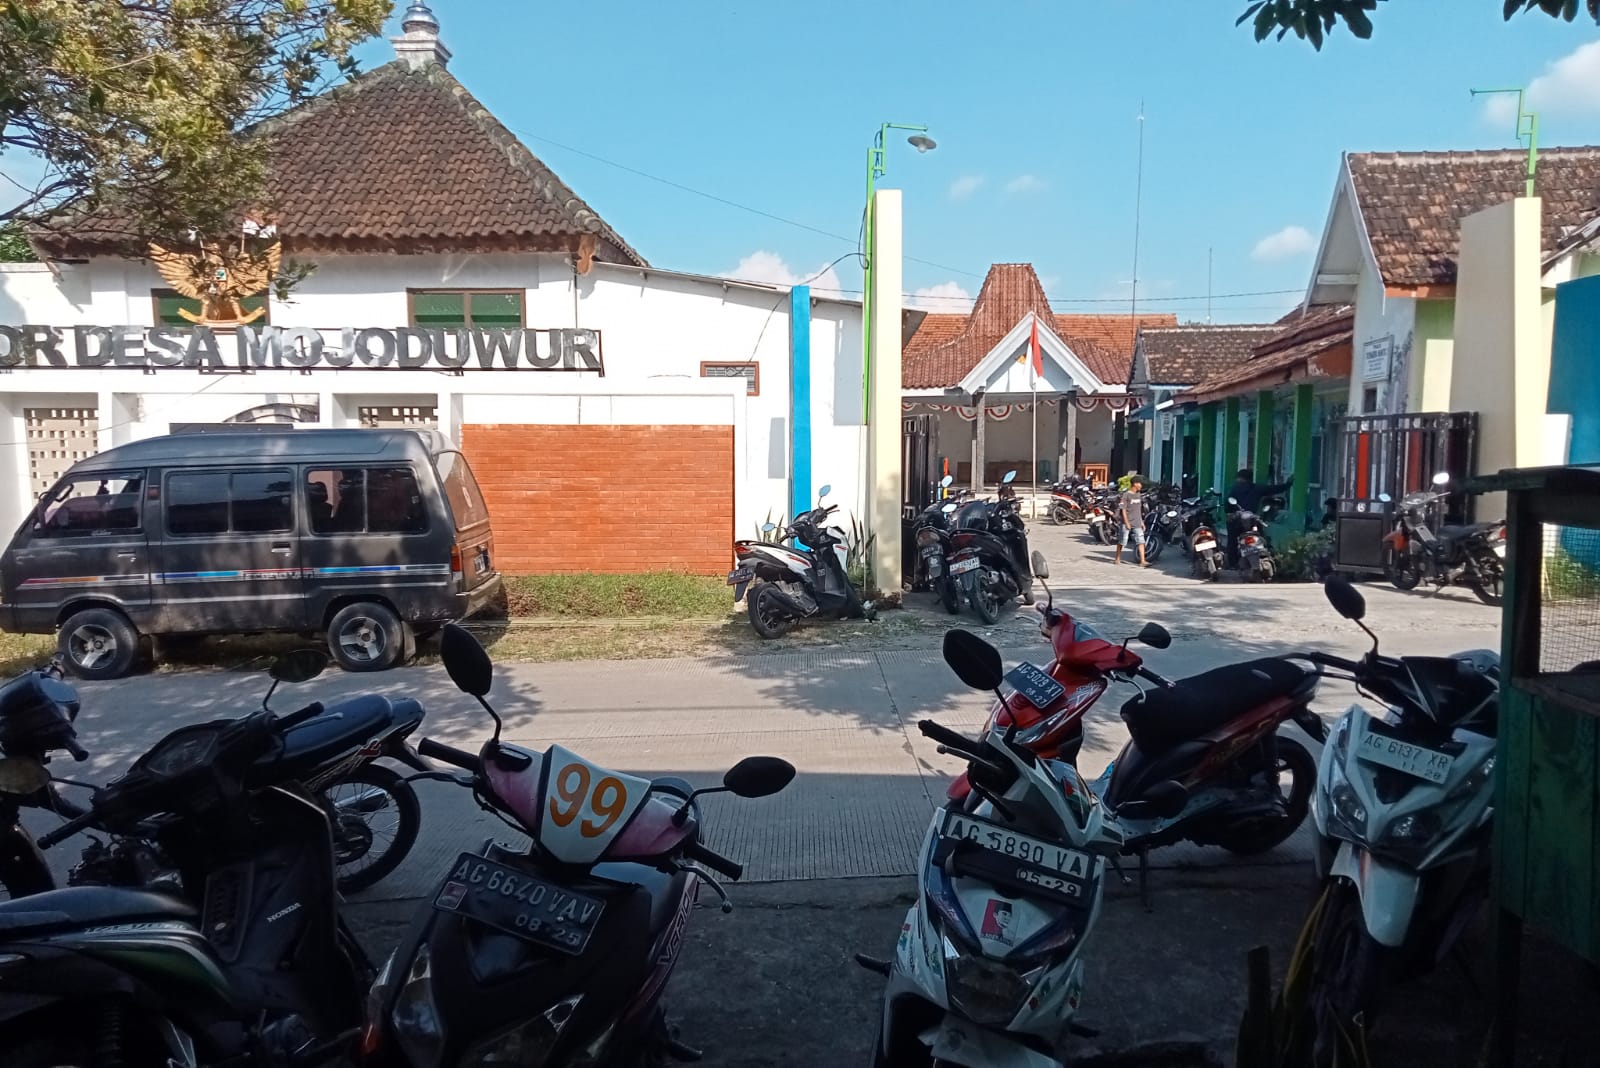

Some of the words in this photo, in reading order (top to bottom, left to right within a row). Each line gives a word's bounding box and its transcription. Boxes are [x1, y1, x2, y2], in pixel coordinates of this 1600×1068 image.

[75, 325, 227, 367] DESA
[236, 325, 602, 369] MOJODUWUR
[1364, 734, 1383, 748] AG
[1387, 741, 1423, 761] 6137
[1427, 753, 1449, 769] XR
[549, 763, 628, 839] 99
[950, 819, 980, 842] AG
[986, 831, 1045, 865] 5890
[1056, 852, 1083, 876] VA
[265, 901, 303, 923] HONDA
[453, 859, 488, 884] AG
[487, 870, 547, 906] 6640
[548, 891, 596, 924] VAV
